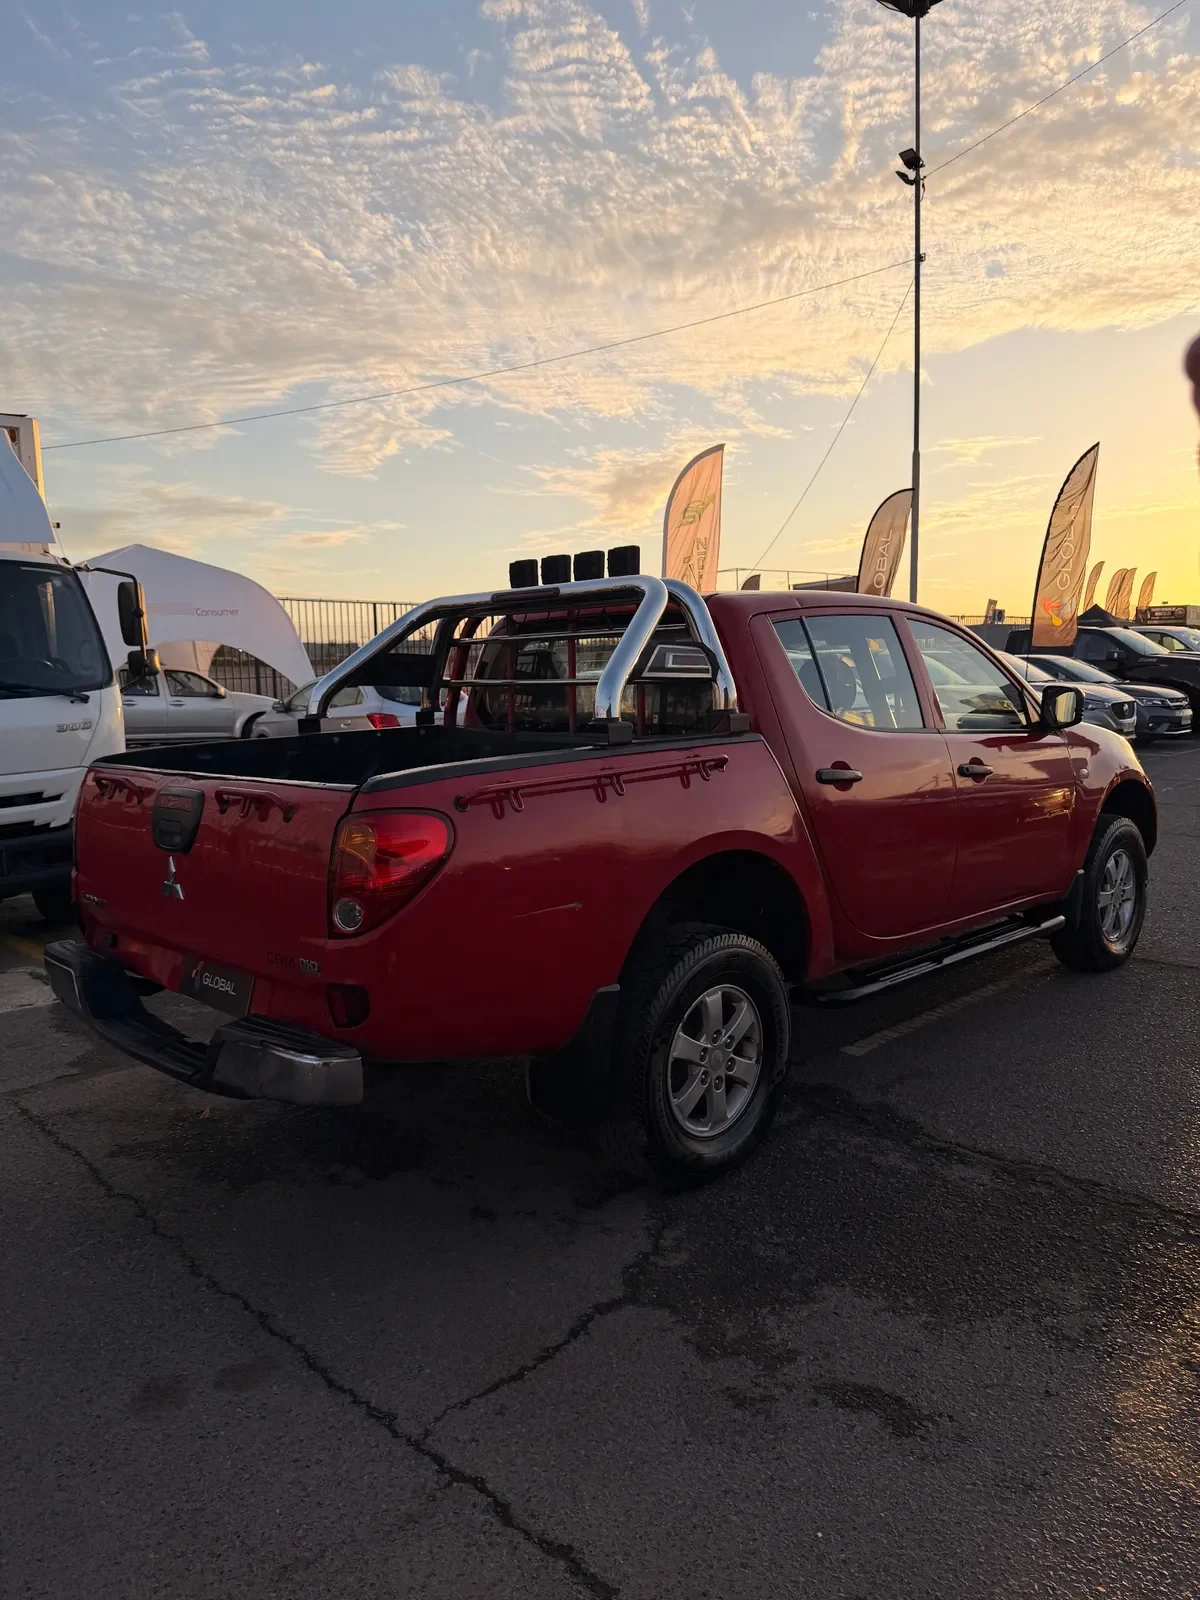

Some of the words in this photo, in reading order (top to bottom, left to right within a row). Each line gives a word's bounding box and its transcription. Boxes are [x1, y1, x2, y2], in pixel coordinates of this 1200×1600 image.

[195, 607, 239, 617] Consumer
[55, 720, 93, 733] 300
[202, 972, 237, 996] GLOBAL
